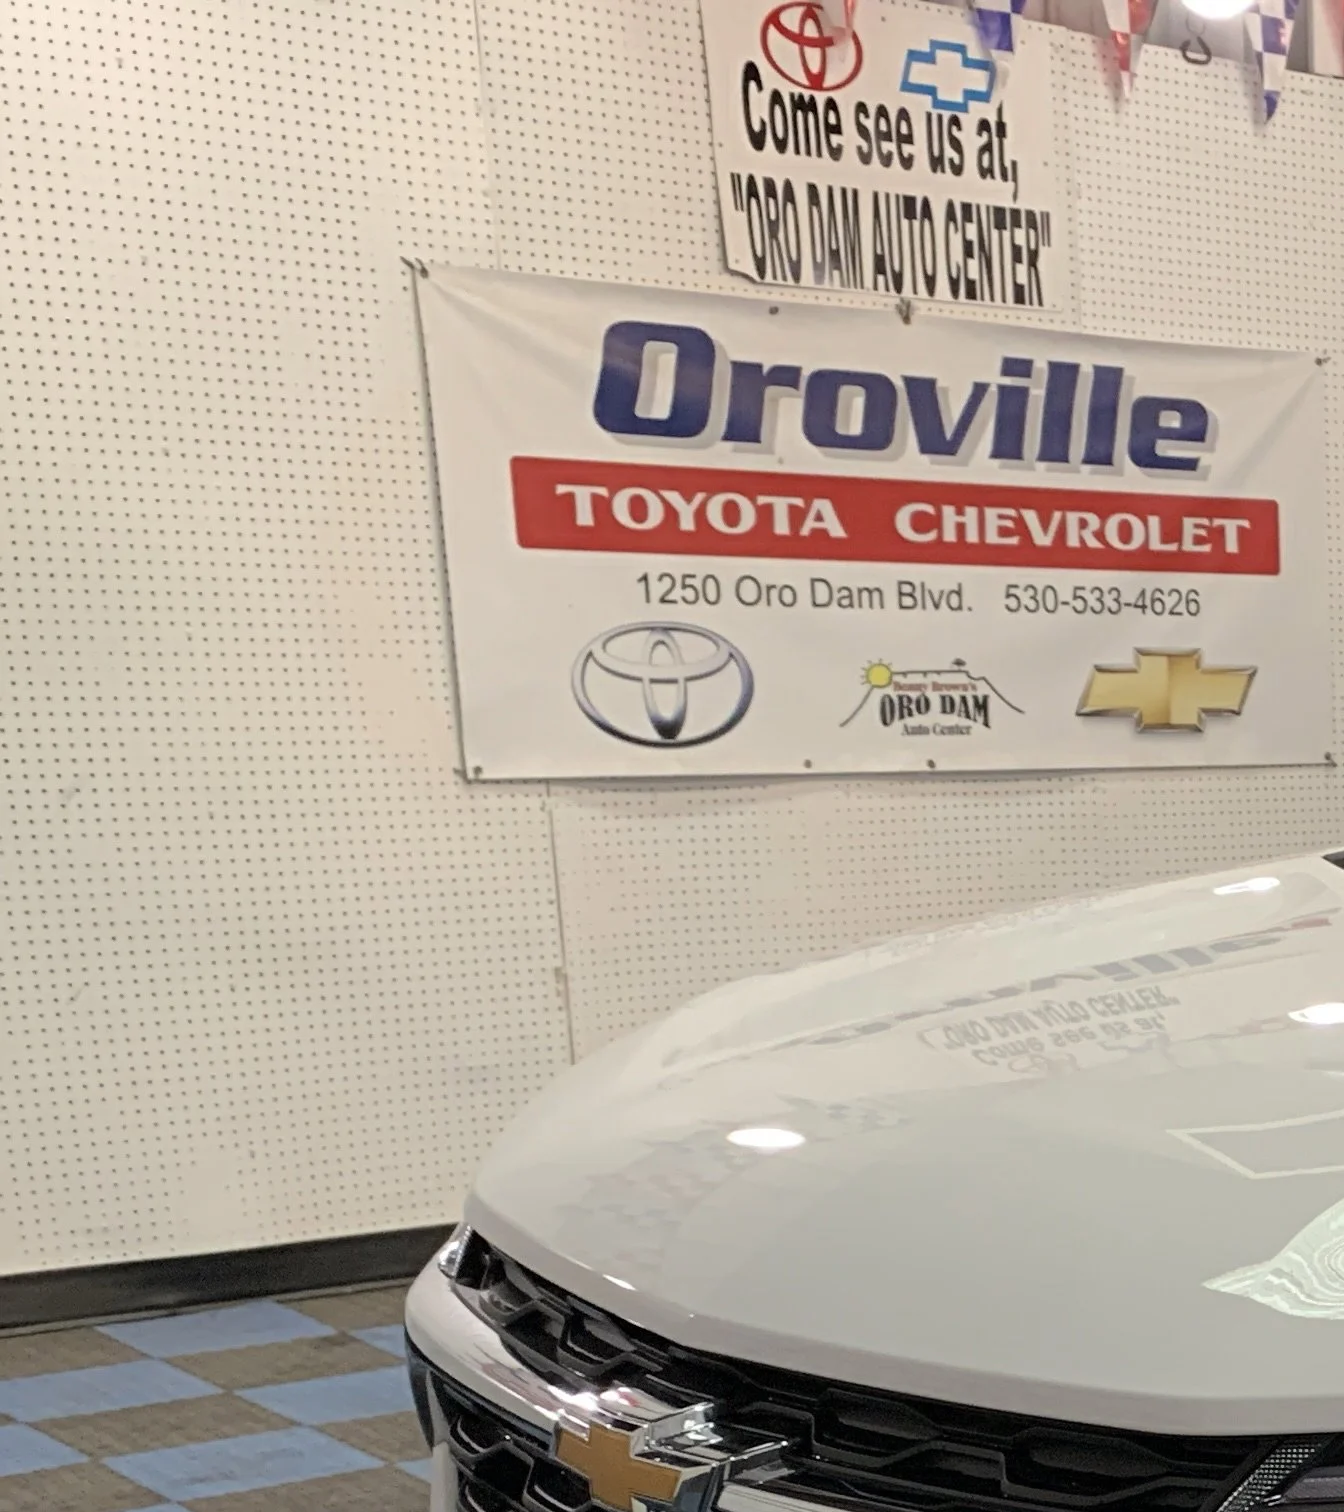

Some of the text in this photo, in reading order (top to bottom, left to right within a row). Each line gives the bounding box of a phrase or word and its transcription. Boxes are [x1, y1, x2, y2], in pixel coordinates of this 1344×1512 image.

[742, 61, 1018, 203] Come see us at,
[730, 172, 1051, 308] "ORO DAM AUTO CENTER"
[592, 320, 1210, 472] Oroville
[556, 482, 1251, 555] TOYOTA CHEVROLET
[636, 574, 1201, 617] 1250 Oro Dam Blvd. 530-533-4626
[880, 692, 991, 729] ORO DAM
[902, 723, 972, 736] Auto Center
